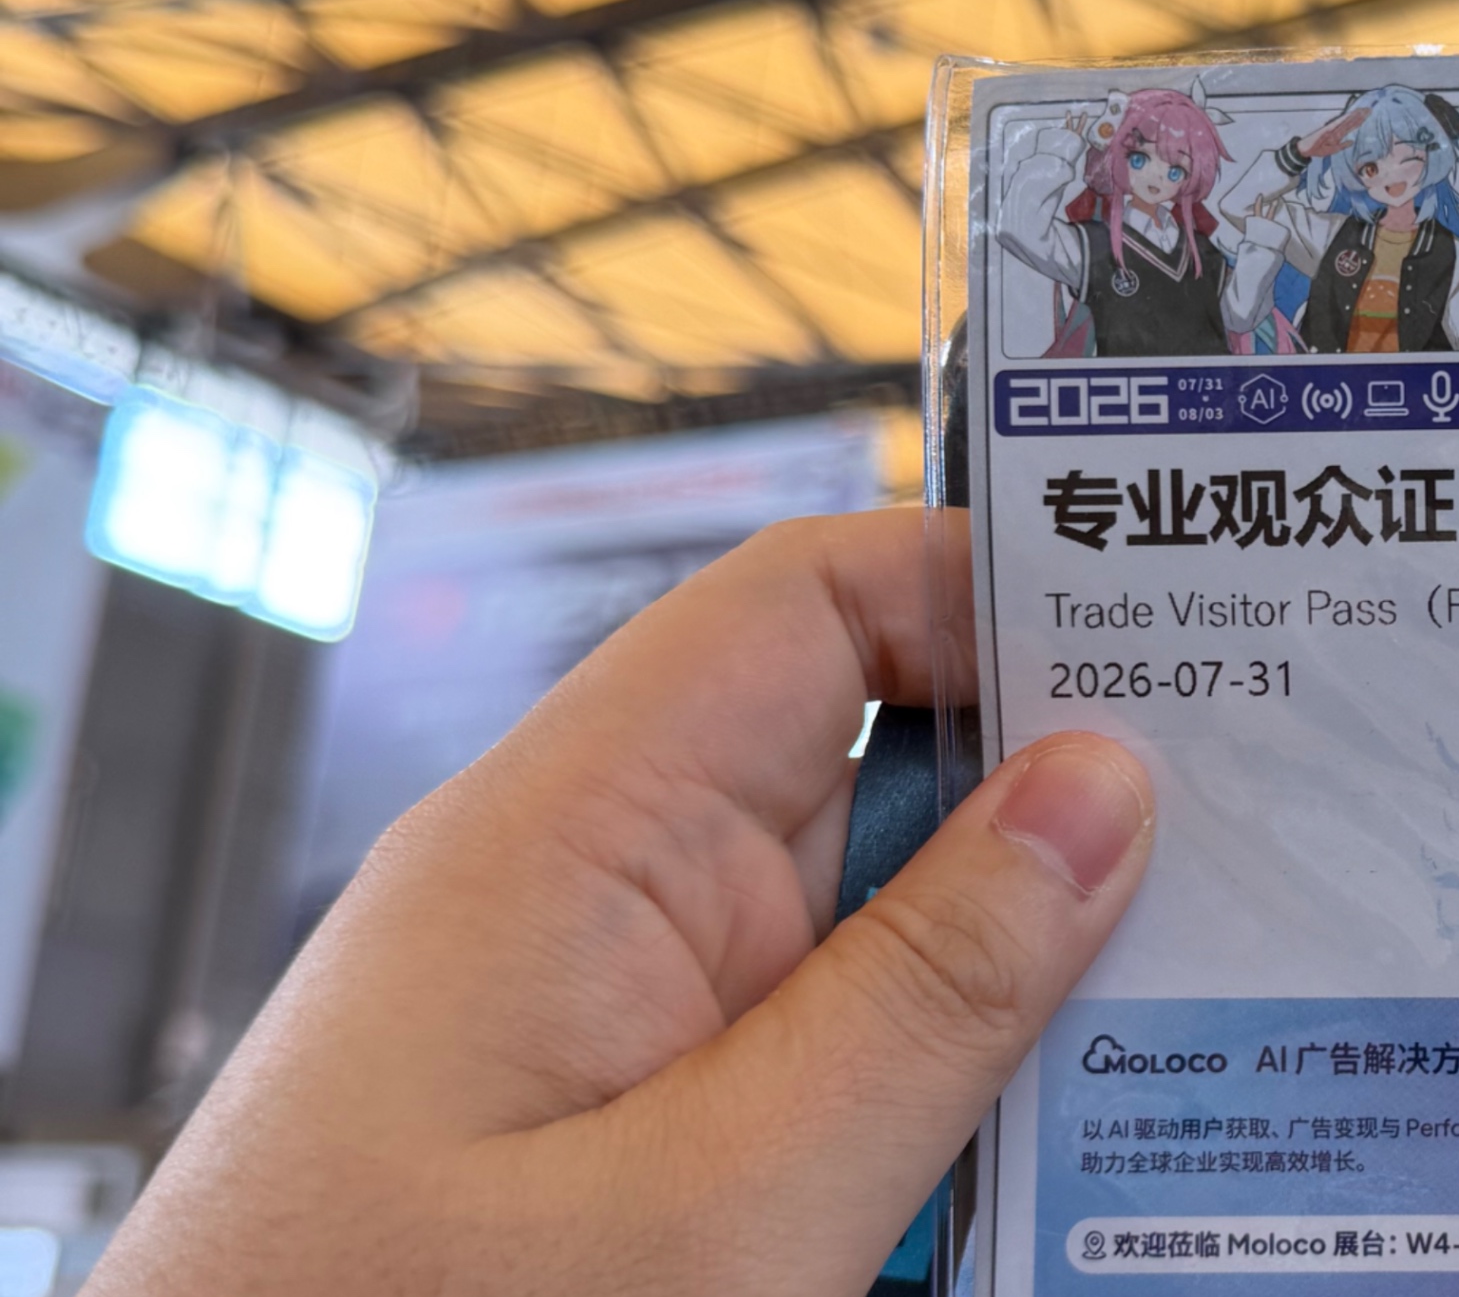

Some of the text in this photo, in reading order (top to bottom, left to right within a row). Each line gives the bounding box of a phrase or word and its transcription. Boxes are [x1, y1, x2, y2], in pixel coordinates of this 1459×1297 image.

[1178, 378, 1224, 392] 07/31
[1009, 376, 1169, 426] 2026
[1250, 389, 1275, 410] AI
[1178, 407, 1224, 421] 08/03
[1046, 592, 1154, 629] Trade
[1168, 590, 1292, 628] Visitor
[1308, 590, 1398, 626] Pass
[1049, 661, 1293, 700] 2026-07-31
[1103, 1052, 1229, 1074] MOLOCO
[1081, 1150, 1365, 1174] 助力全球企业实现高效增长。
[1113, 1232, 1221, 1258] 欢迎莅临
[1228, 1233, 1326, 1256] Moloco
